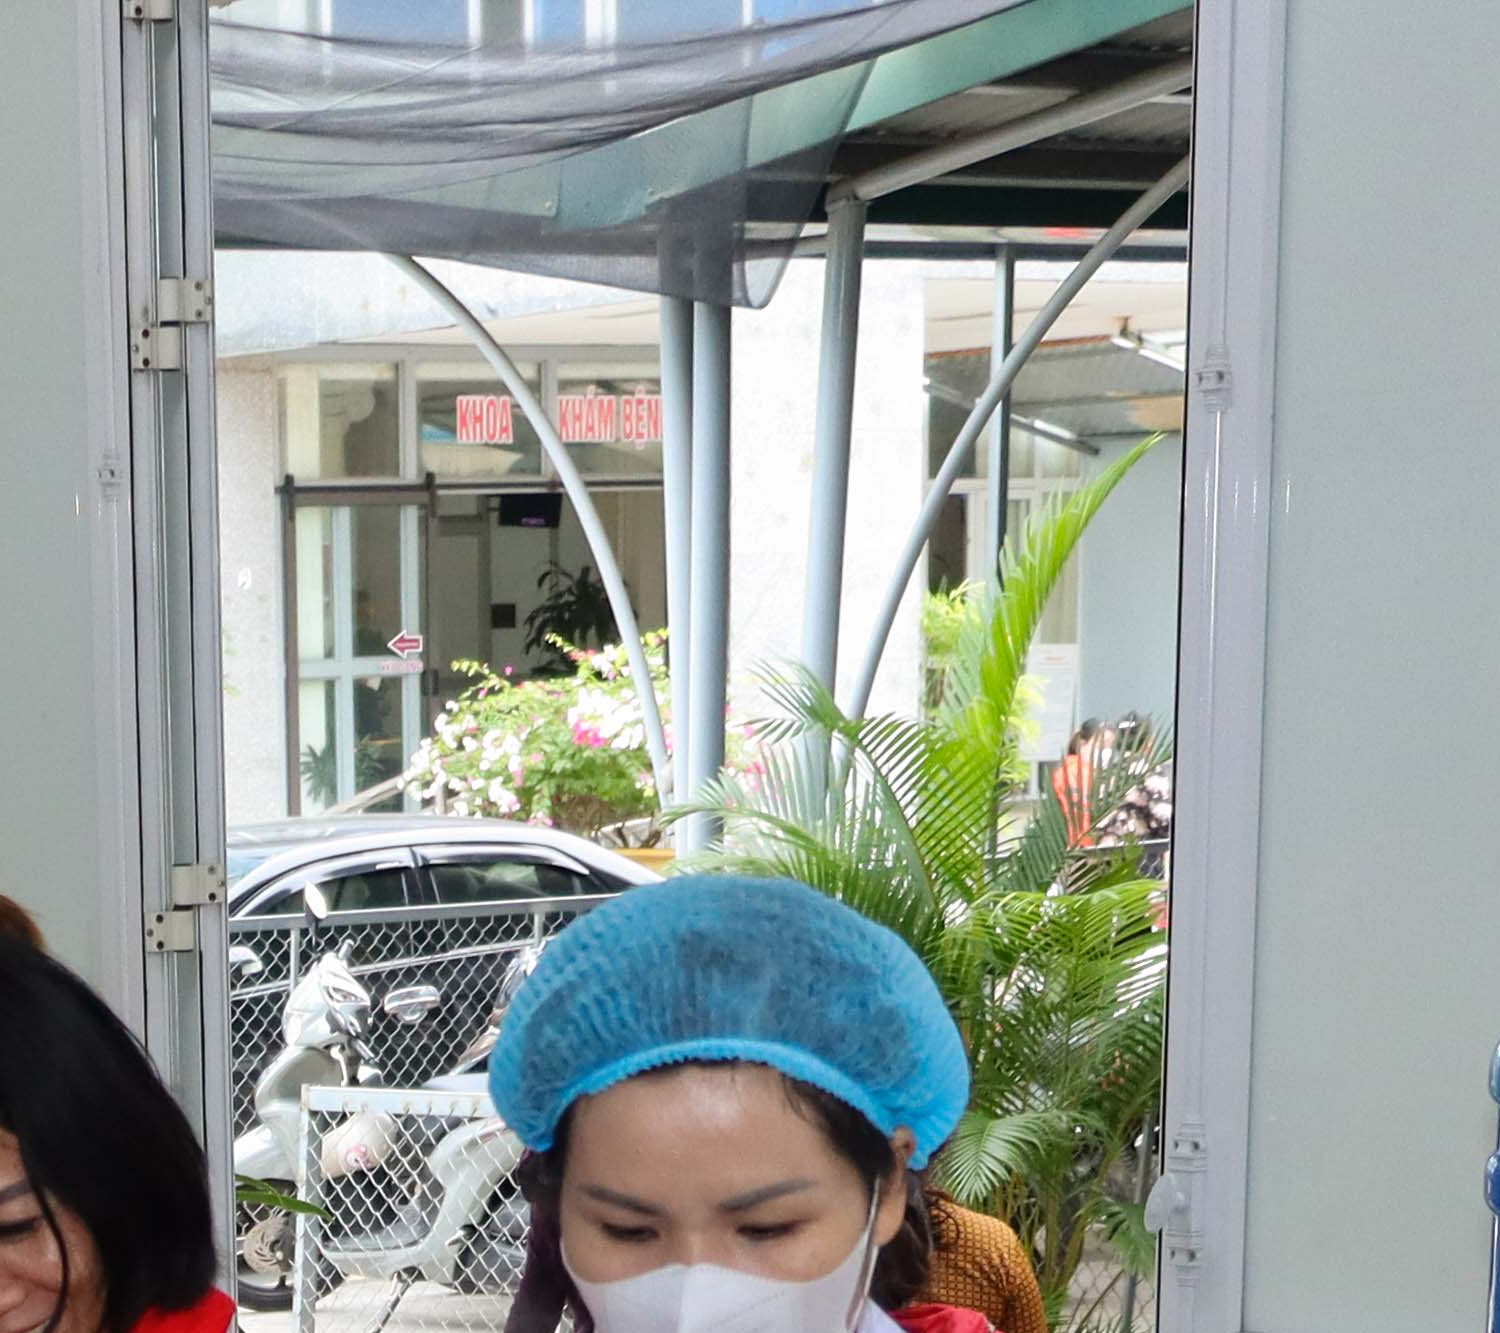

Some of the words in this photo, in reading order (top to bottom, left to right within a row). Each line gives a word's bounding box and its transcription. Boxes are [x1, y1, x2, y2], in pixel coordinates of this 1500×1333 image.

[456, 395, 513, 444] KHOA
[557, 385, 617, 443] KHÁM
[620, 382, 663, 449] BỆN
